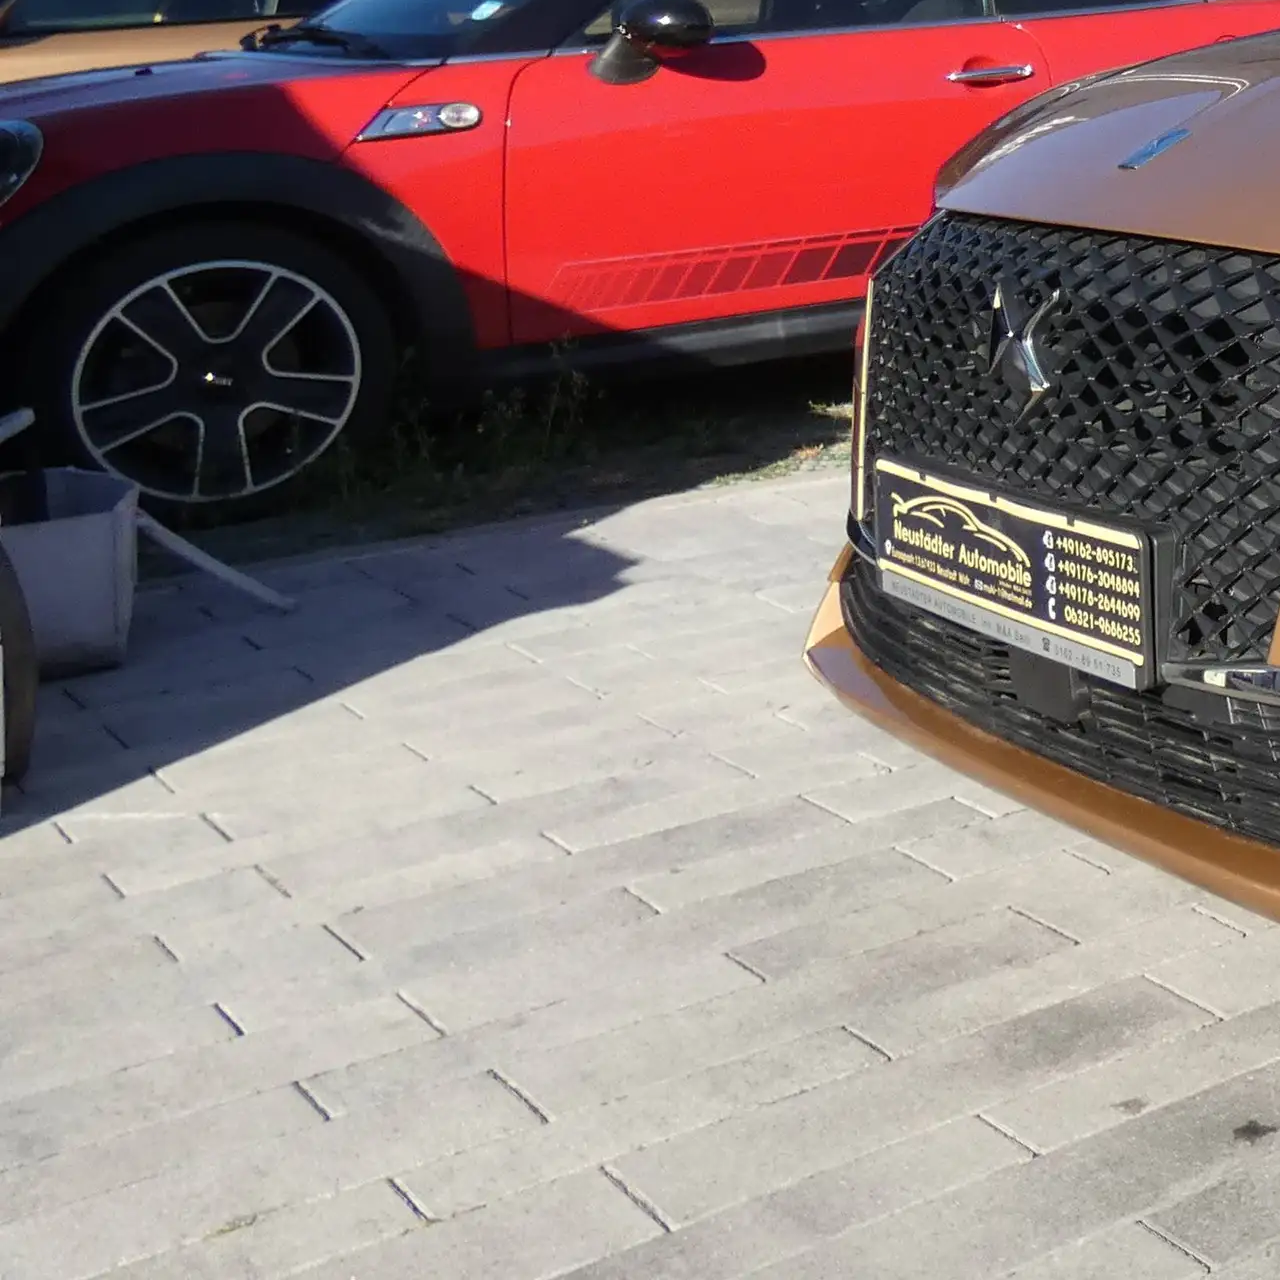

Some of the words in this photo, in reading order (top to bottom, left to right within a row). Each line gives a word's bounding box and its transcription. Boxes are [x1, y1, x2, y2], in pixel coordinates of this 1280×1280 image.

[892, 518, 956, 560] Neustädter
[958, 543, 1033, 588] Automobile
[1063, 604, 1141, 646] 06321-9686255
